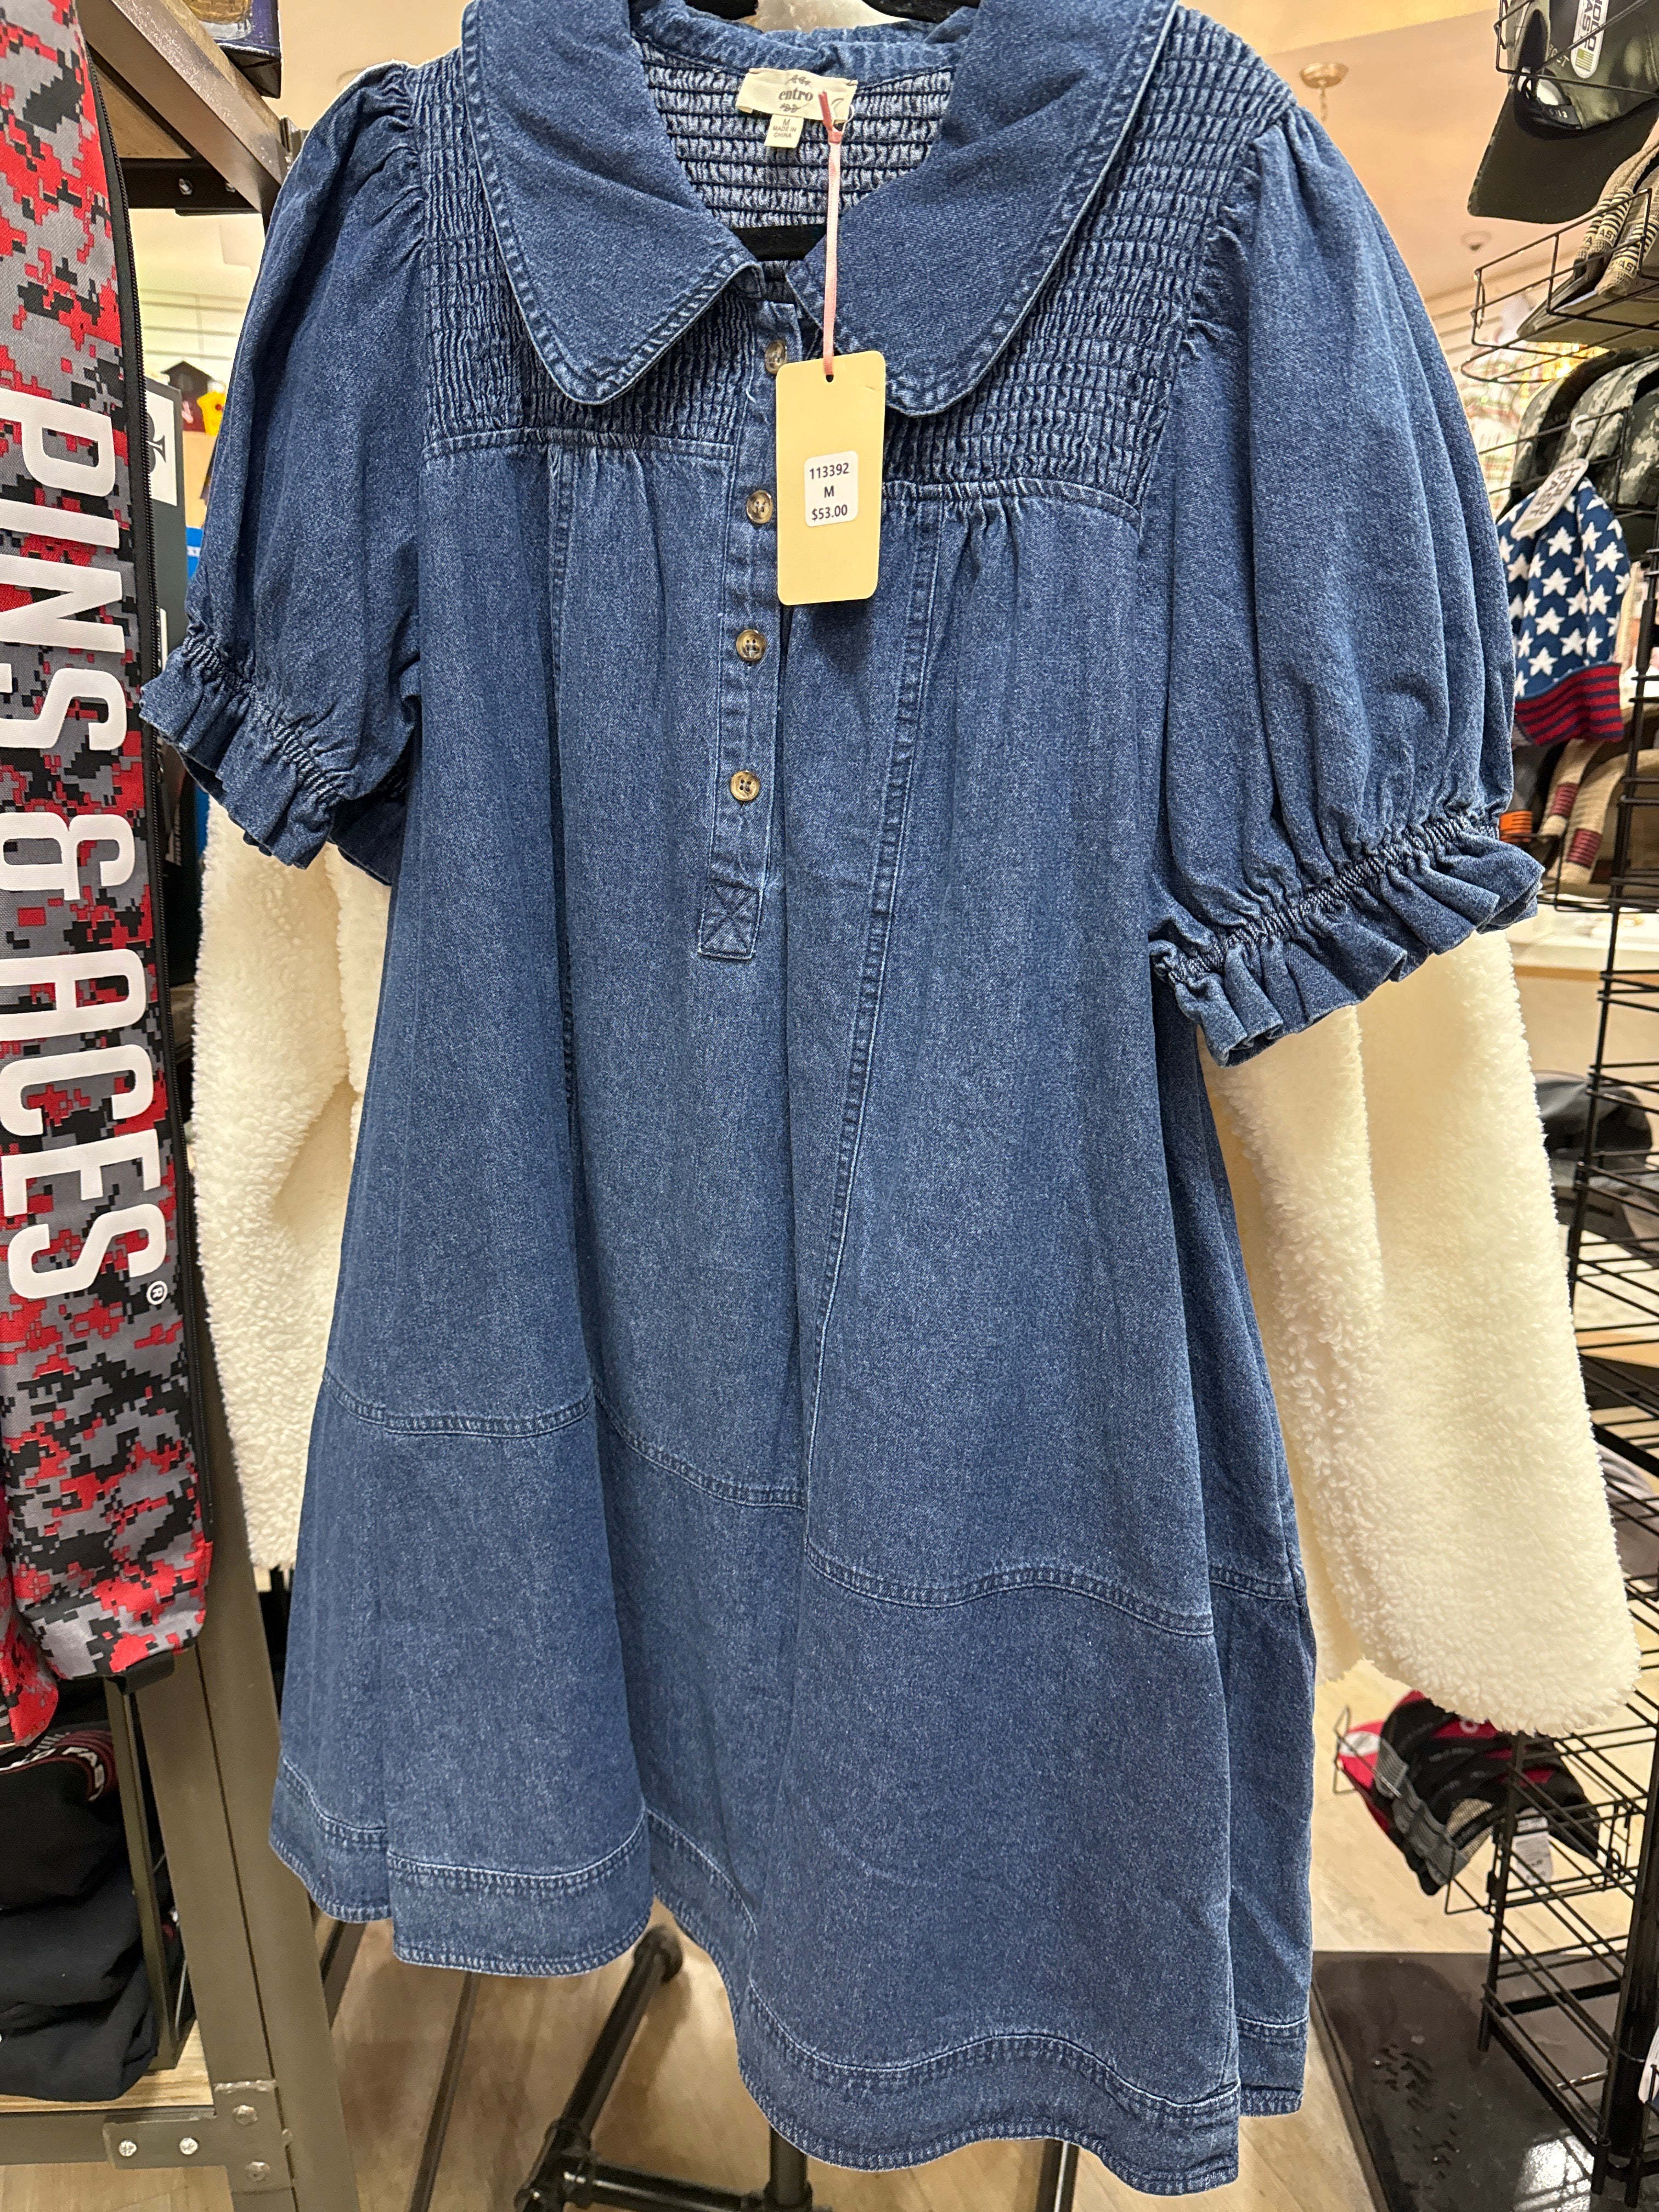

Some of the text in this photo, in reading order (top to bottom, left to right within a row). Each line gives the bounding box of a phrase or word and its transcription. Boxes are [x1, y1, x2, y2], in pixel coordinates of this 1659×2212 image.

[778, 88, 813, 101] entro
[809, 462, 850, 479] 113392
[823, 486, 834, 498] M
[811, 504, 848, 522] $53.00
[0, 390, 127, 750] PINS
[0, 812, 135, 900] &
